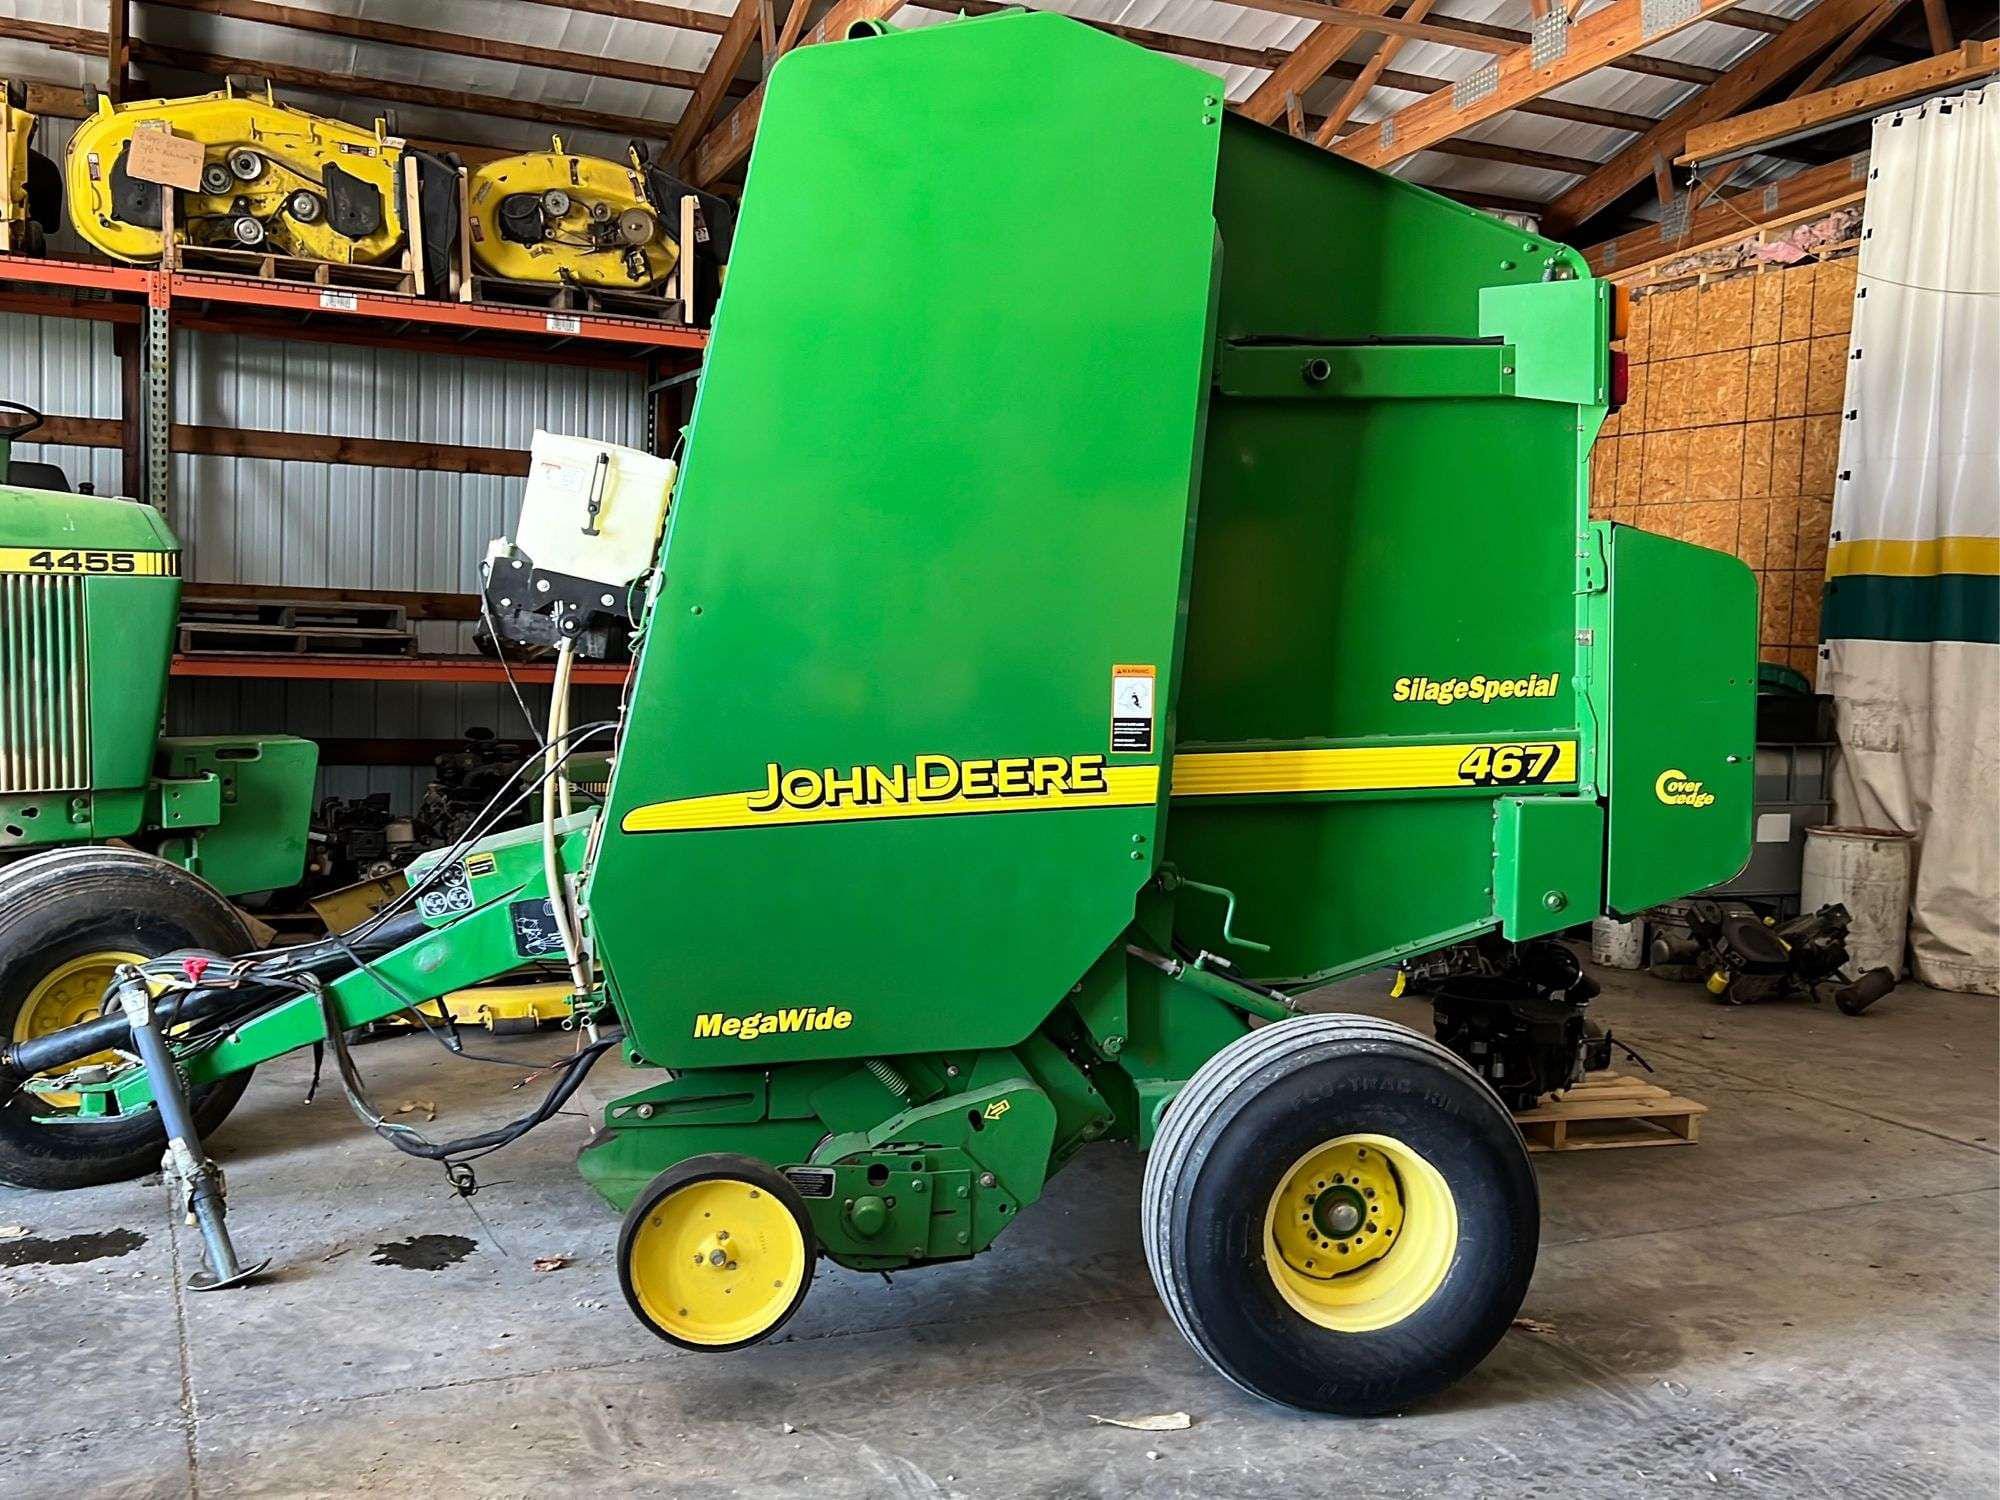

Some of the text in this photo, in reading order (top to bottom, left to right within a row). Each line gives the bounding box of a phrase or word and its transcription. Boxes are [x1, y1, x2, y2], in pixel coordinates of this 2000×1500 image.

[29, 551, 135, 573] 4455
[1393, 672, 1560, 705] SilageSpecial
[747, 753, 1107, 812] JOHN DEERE
[1458, 744, 1560, 786] 467
[693, 1006, 853, 1041] MegaWide
